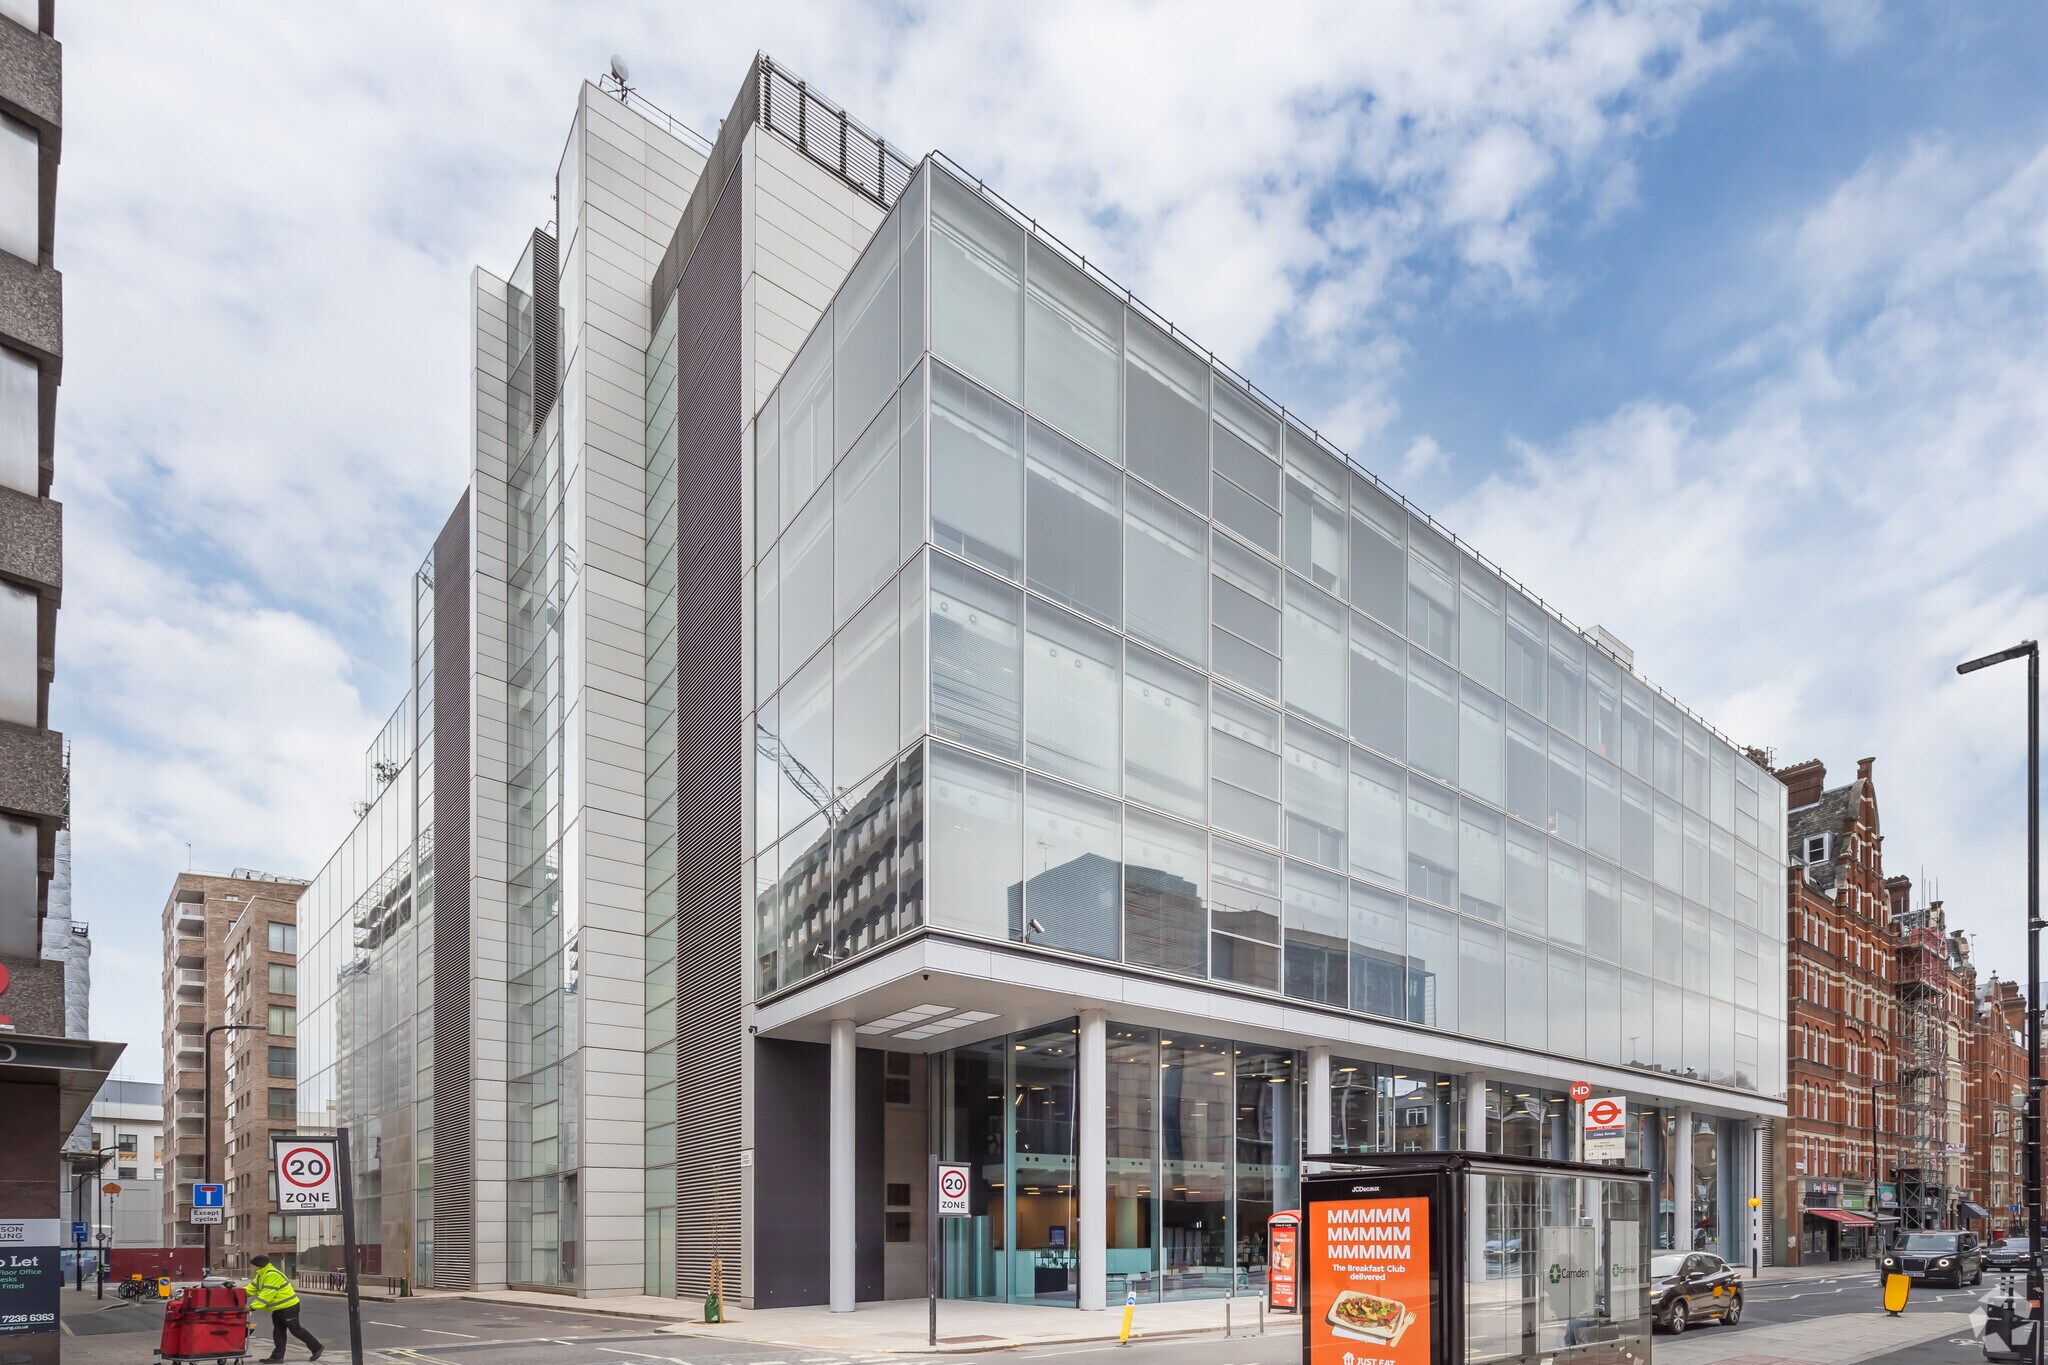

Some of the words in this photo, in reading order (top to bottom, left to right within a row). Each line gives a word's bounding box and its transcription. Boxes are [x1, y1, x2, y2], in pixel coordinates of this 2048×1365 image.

[1572, 1086, 1589, 1096] HD
[289, 1159, 324, 1176] 20
[945, 1178, 963, 1190] 20
[285, 1192, 330, 1203] ZONE
[941, 1201, 966, 1209] ZONE
[193, 1210, 219, 1218] Except
[1327, 1207, 1411, 1224] MMMMM
[1327, 1226, 1411, 1242] MMMMM
[1327, 1244, 1411, 1260] MMMMM
[10, 1255, 39, 1267] Let
[1347, 1264, 1385, 1272] Breakfast
[1387, 1265, 1406, 1273] Club
[1561, 1268, 1590, 1279] Camden
[1619, 1266, 1637, 1274] Camden
[1349, 1273, 1386, 1281] delivered
[2, 1314, 28, 1323] 7236
[29, 1313, 55, 1321] 6363
